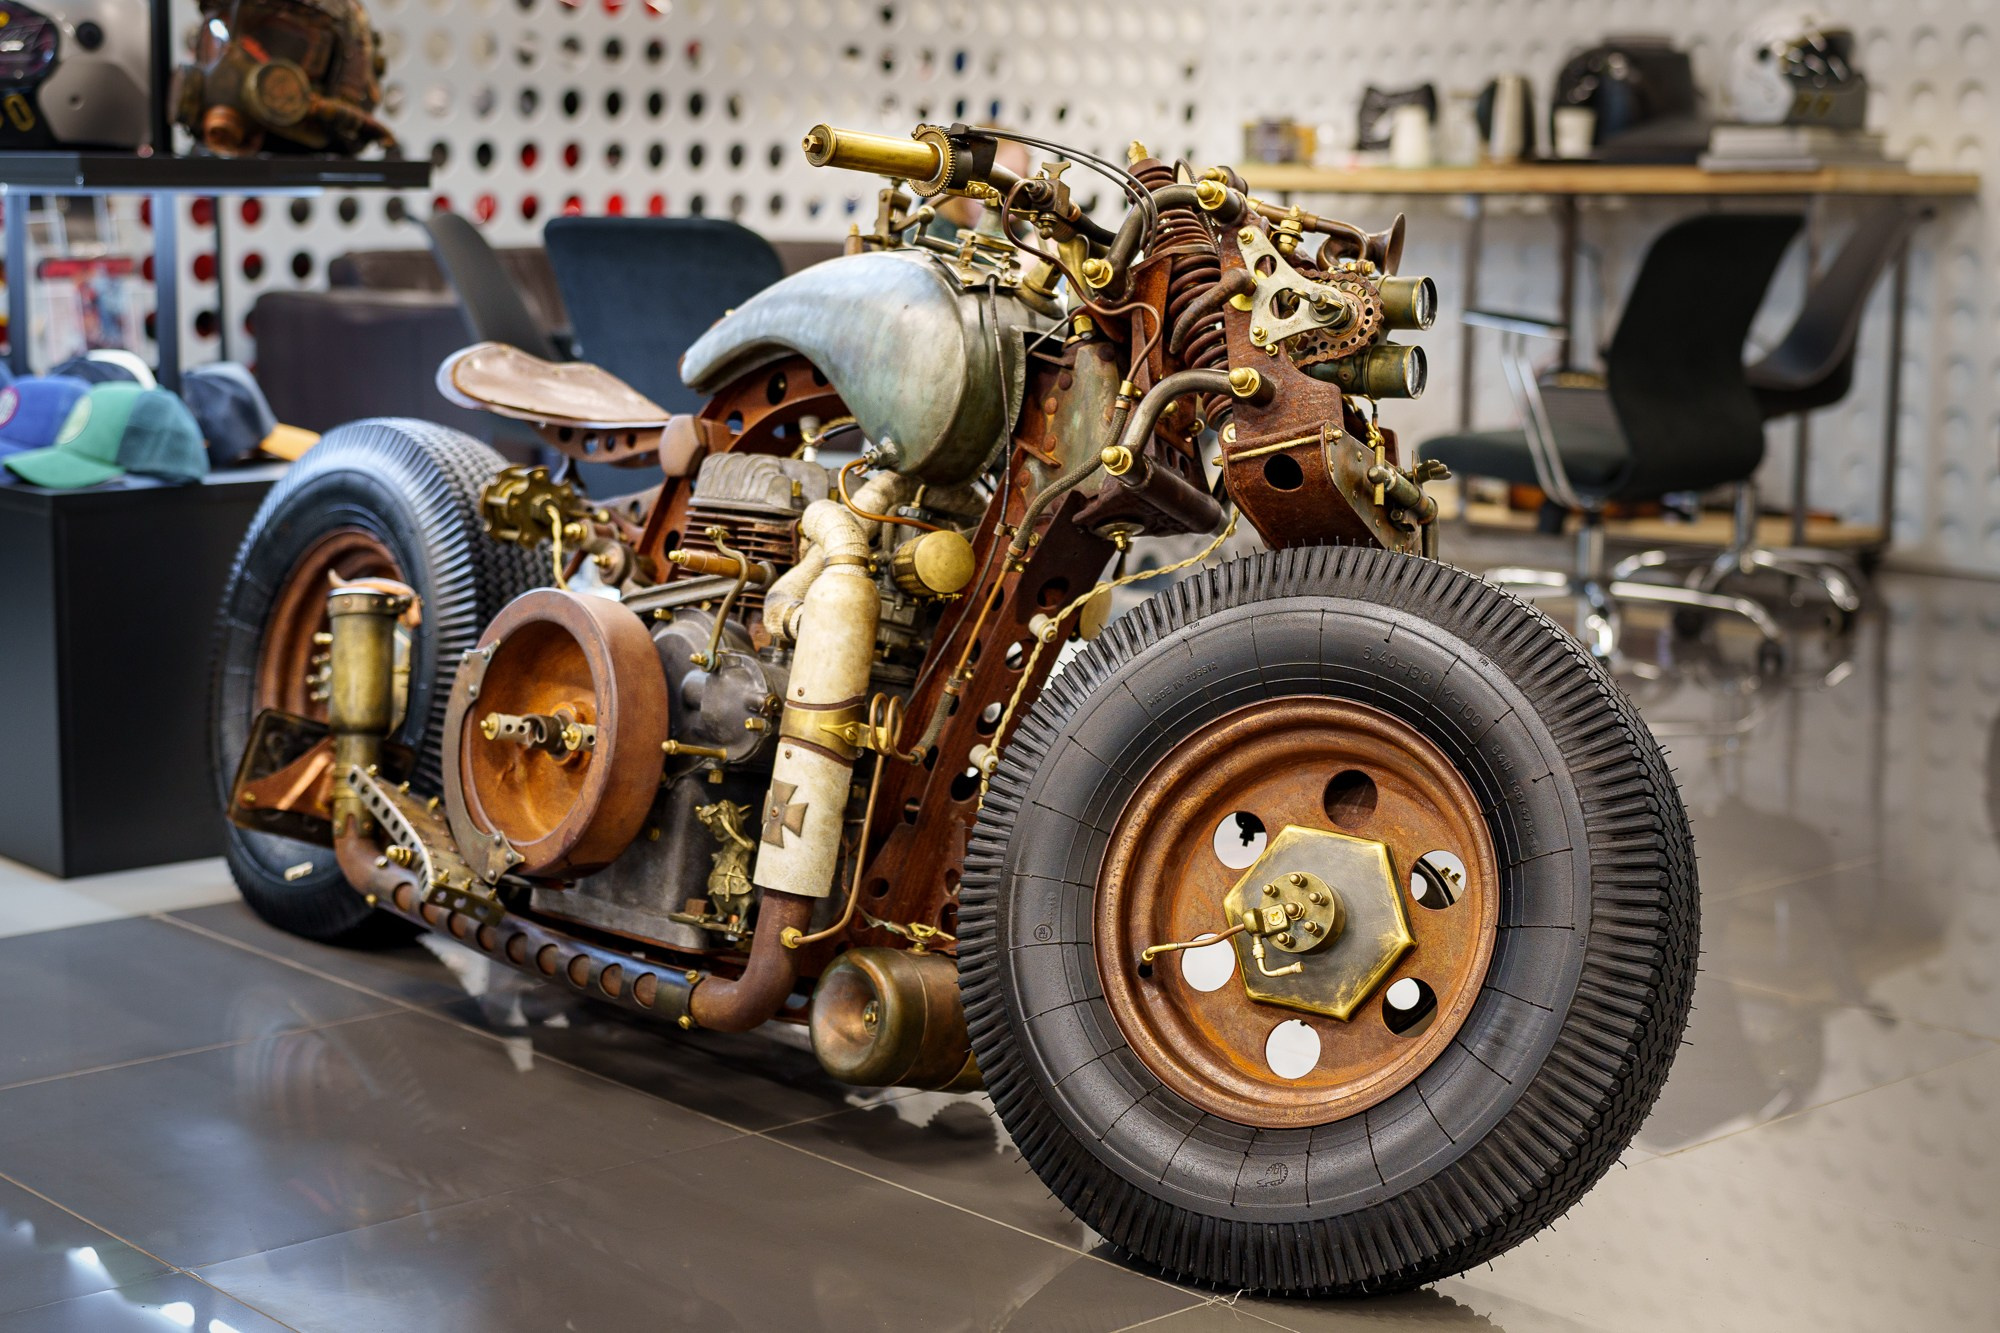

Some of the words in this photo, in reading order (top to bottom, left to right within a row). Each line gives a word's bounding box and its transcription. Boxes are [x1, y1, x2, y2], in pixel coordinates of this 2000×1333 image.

[1147, 686, 1172, 708] MADE
[1173, 680, 1184, 690] IN
[1186, 661, 1218, 683] RUSSIA
